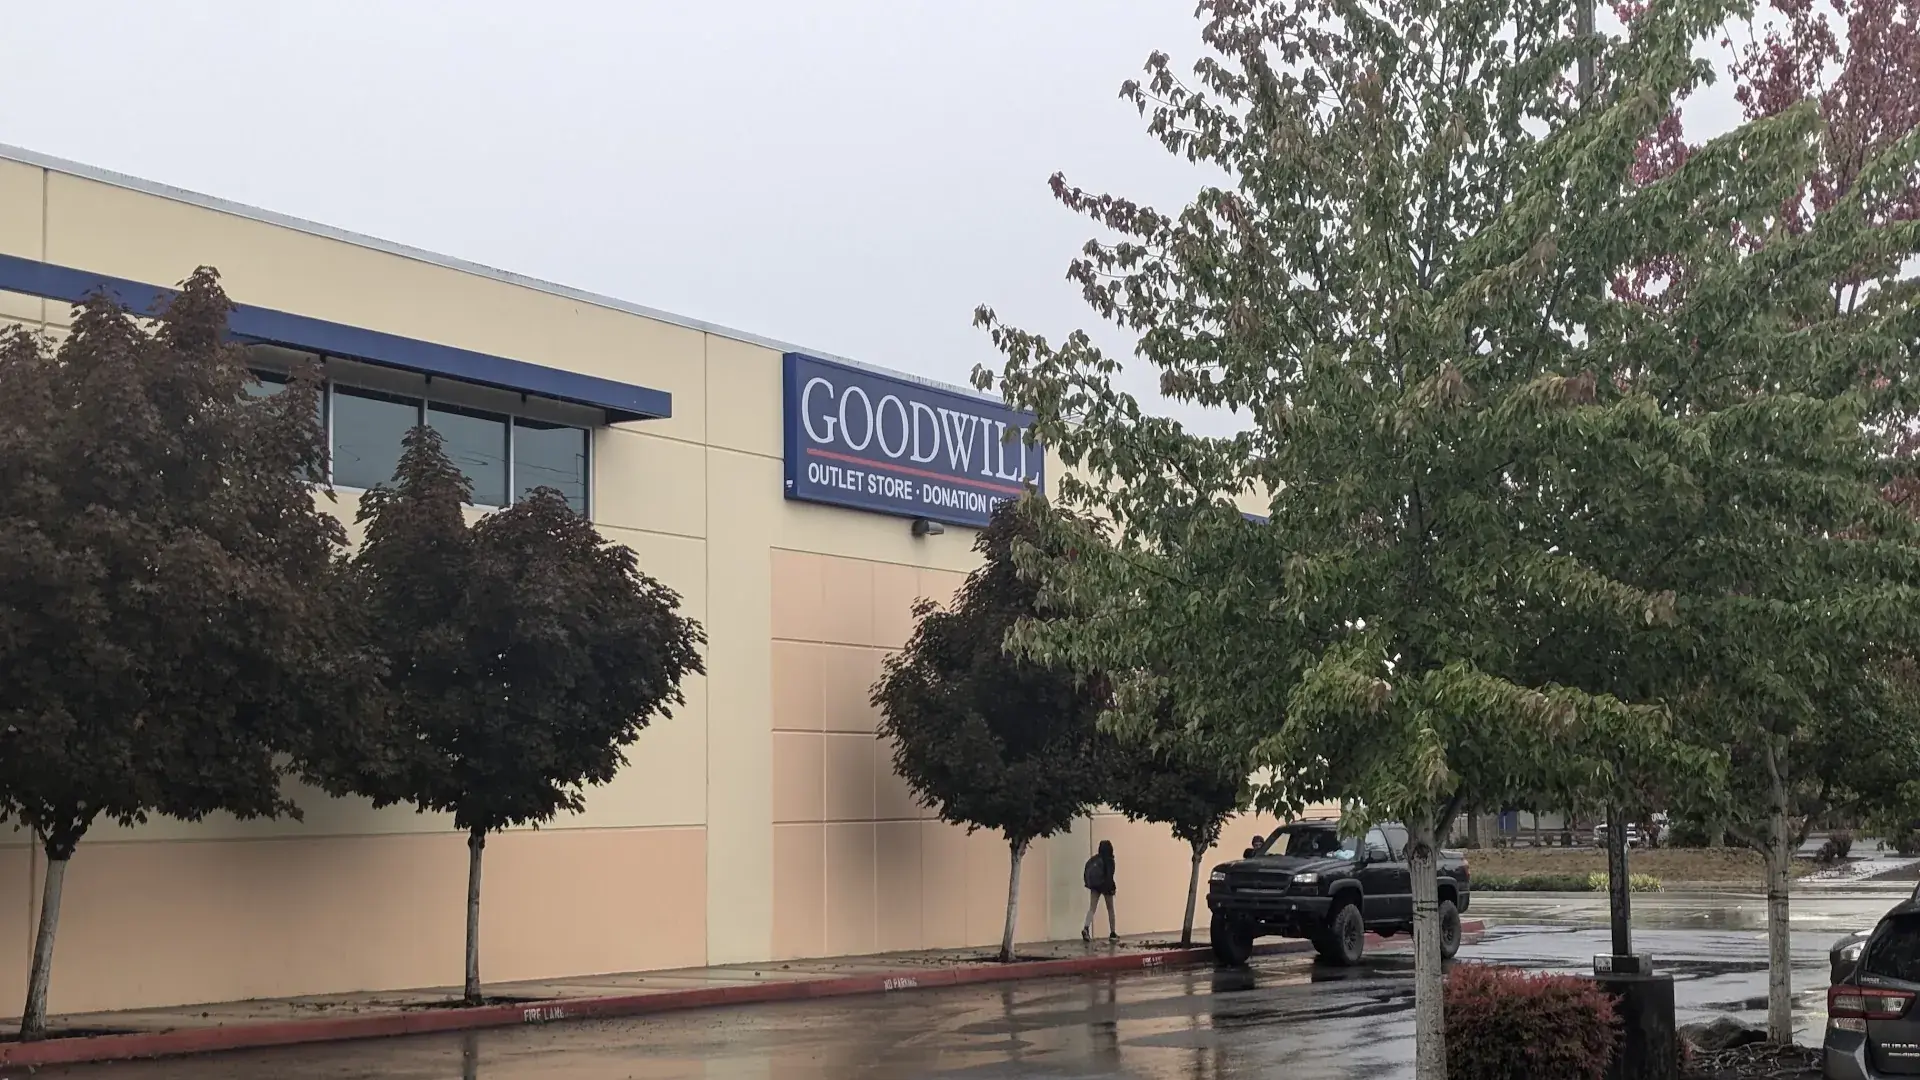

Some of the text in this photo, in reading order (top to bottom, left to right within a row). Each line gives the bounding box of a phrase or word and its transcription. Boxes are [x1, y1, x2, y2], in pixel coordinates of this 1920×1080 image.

[801, 377, 1039, 486] GOODWILL
[808, 462, 864, 492] OUTLET
[867, 474, 913, 499] STORE
[923, 484, 986, 513] DONATION
[524, 1008, 541, 1021] FIRE
